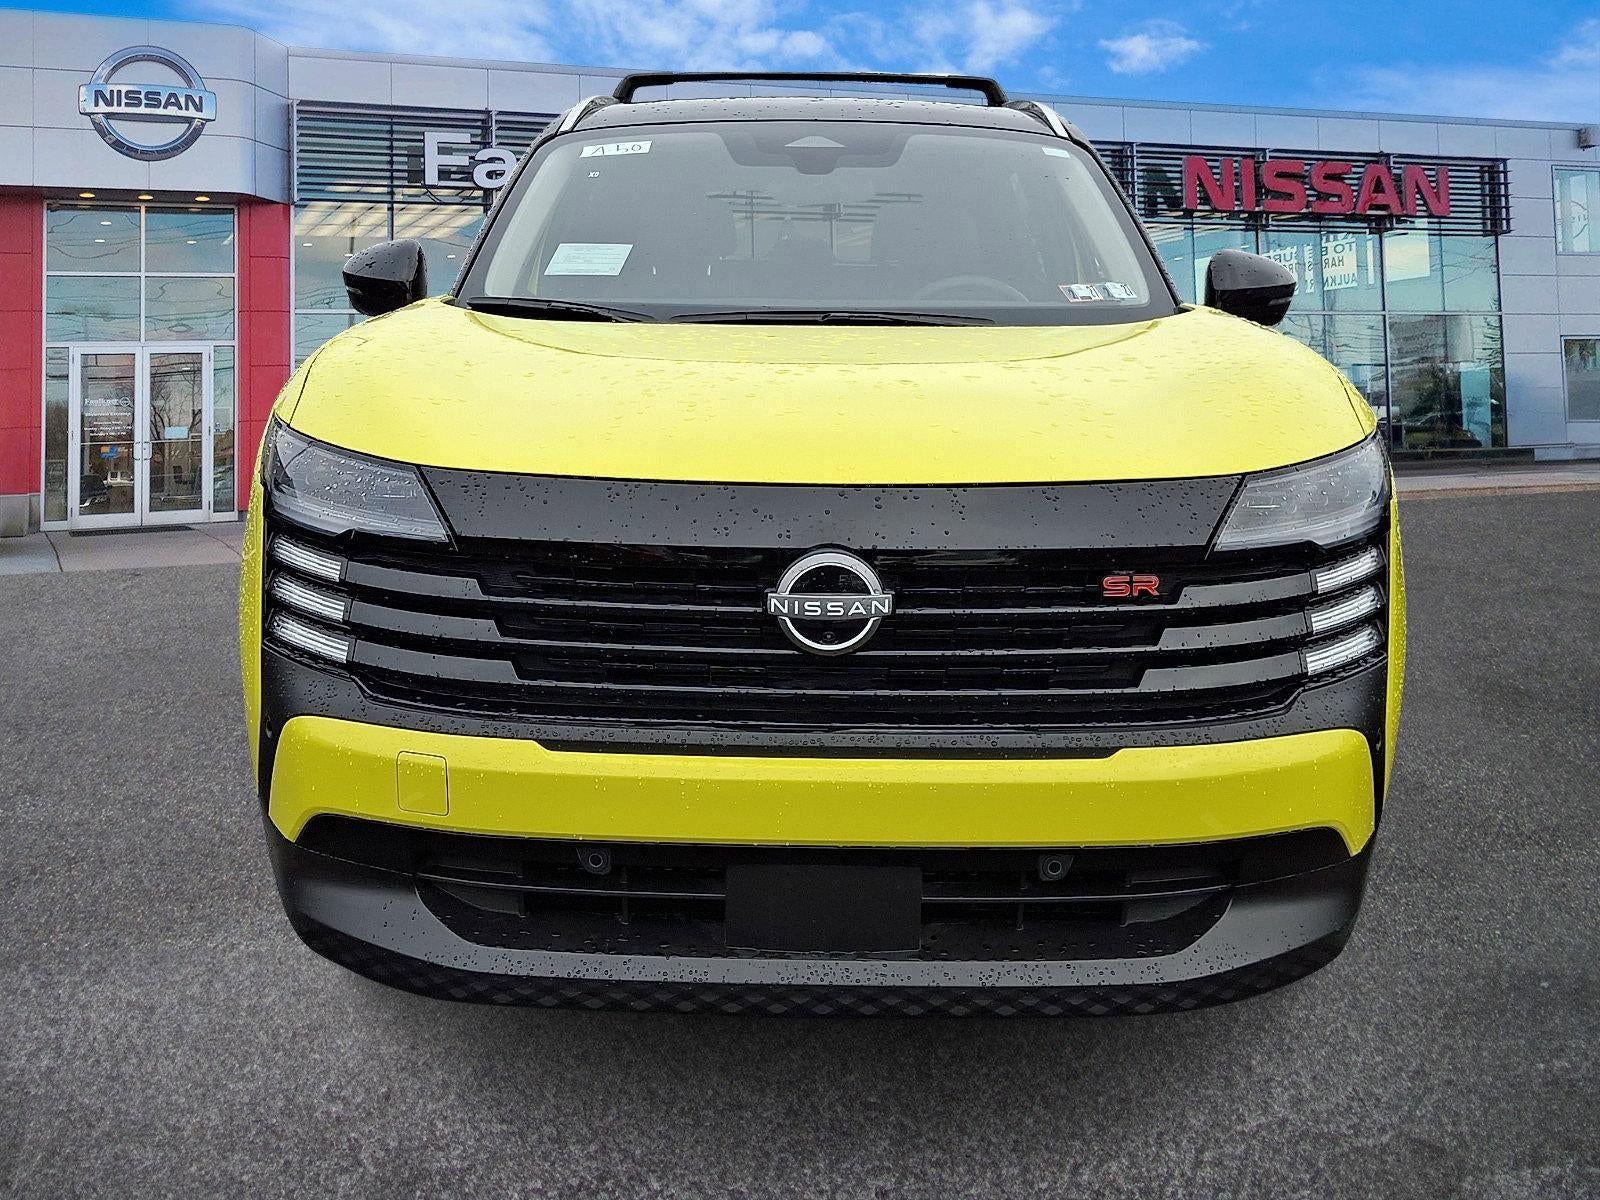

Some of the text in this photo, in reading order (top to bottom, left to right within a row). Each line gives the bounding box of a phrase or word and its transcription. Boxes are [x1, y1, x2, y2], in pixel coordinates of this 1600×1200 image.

[93, 89, 204, 113] NISSAN
[1183, 155, 1450, 217] NISSAN
[1103, 575, 1160, 597] SR
[770, 598, 889, 617] NISSAN
